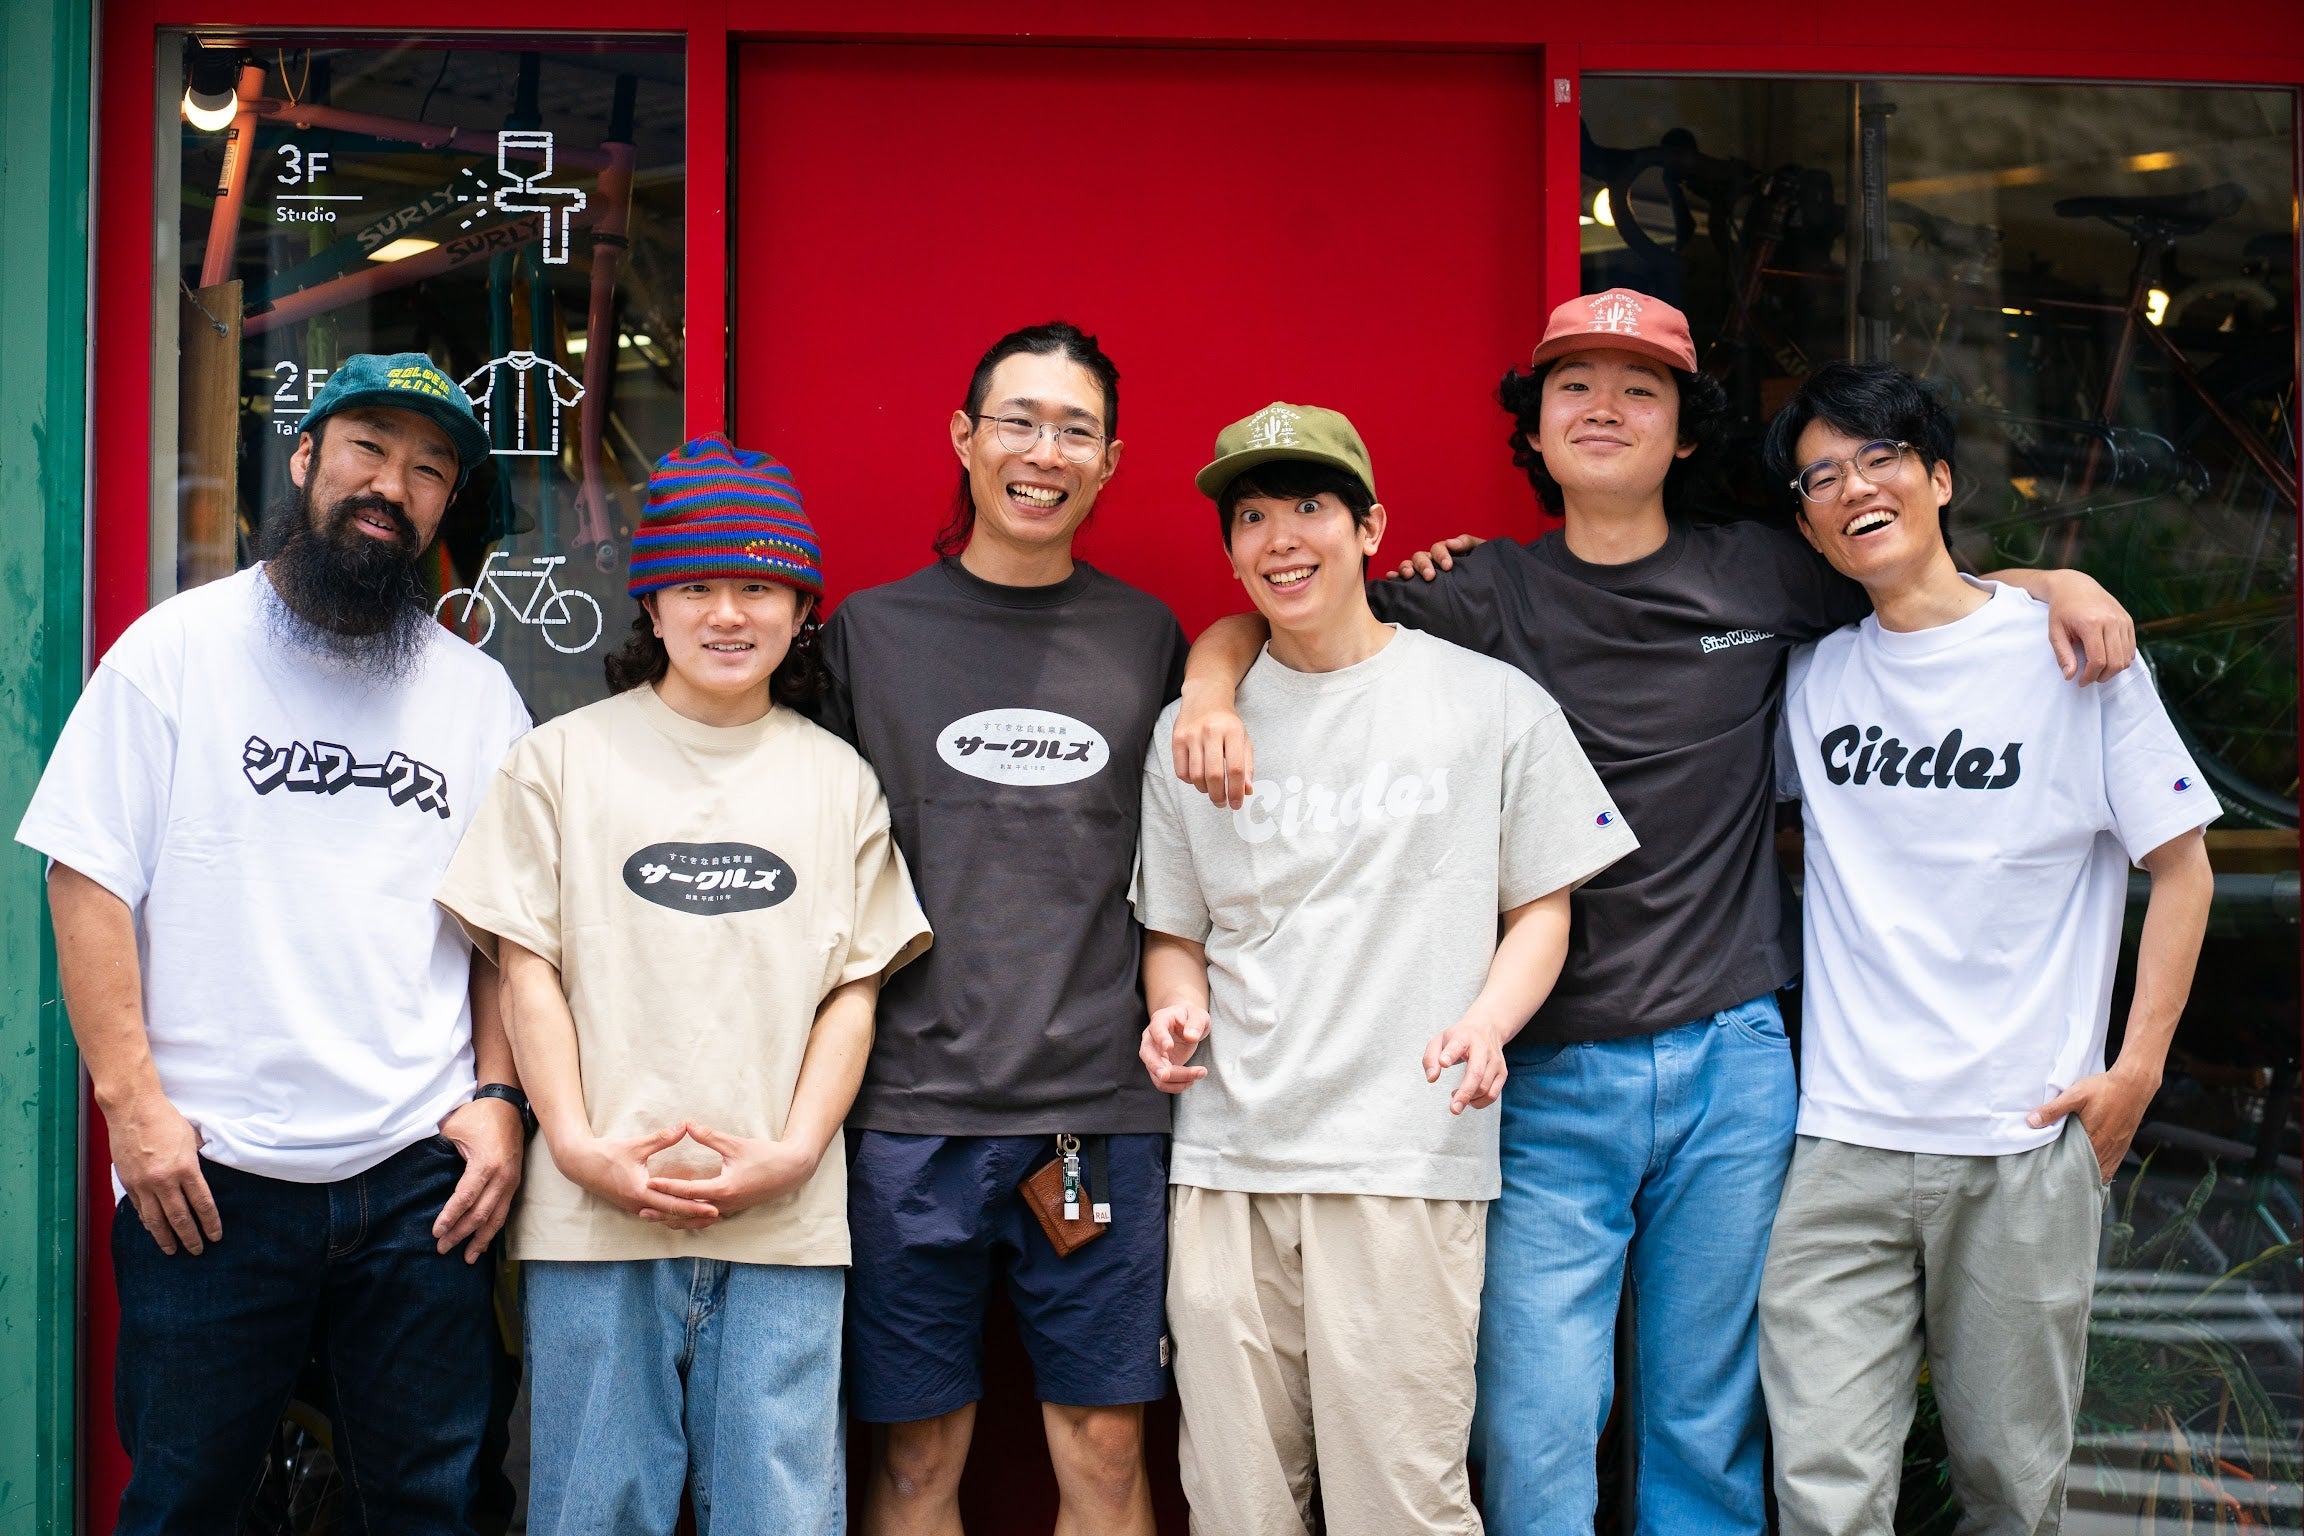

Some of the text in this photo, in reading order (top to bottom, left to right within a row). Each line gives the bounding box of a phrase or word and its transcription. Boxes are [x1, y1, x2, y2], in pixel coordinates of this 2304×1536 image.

[277, 143, 329, 185] 3F
[276, 206, 337, 223] Studio
[356, 184, 454, 250] SURLY
[446, 216, 541, 263] SURLY
[274, 360, 329, 401] 2F
[387, 366, 450, 395] GOLDEN
[388, 378, 449, 400] PLIER
[273, 420, 299, 436] Tai
[954, 736, 1094, 762] サークルズ
[1820, 724, 2023, 789] Circles
[243, 735, 451, 819] シムワークス
[1232, 761, 1451, 844] Circles
[639, 863, 781, 892] サークルズ
